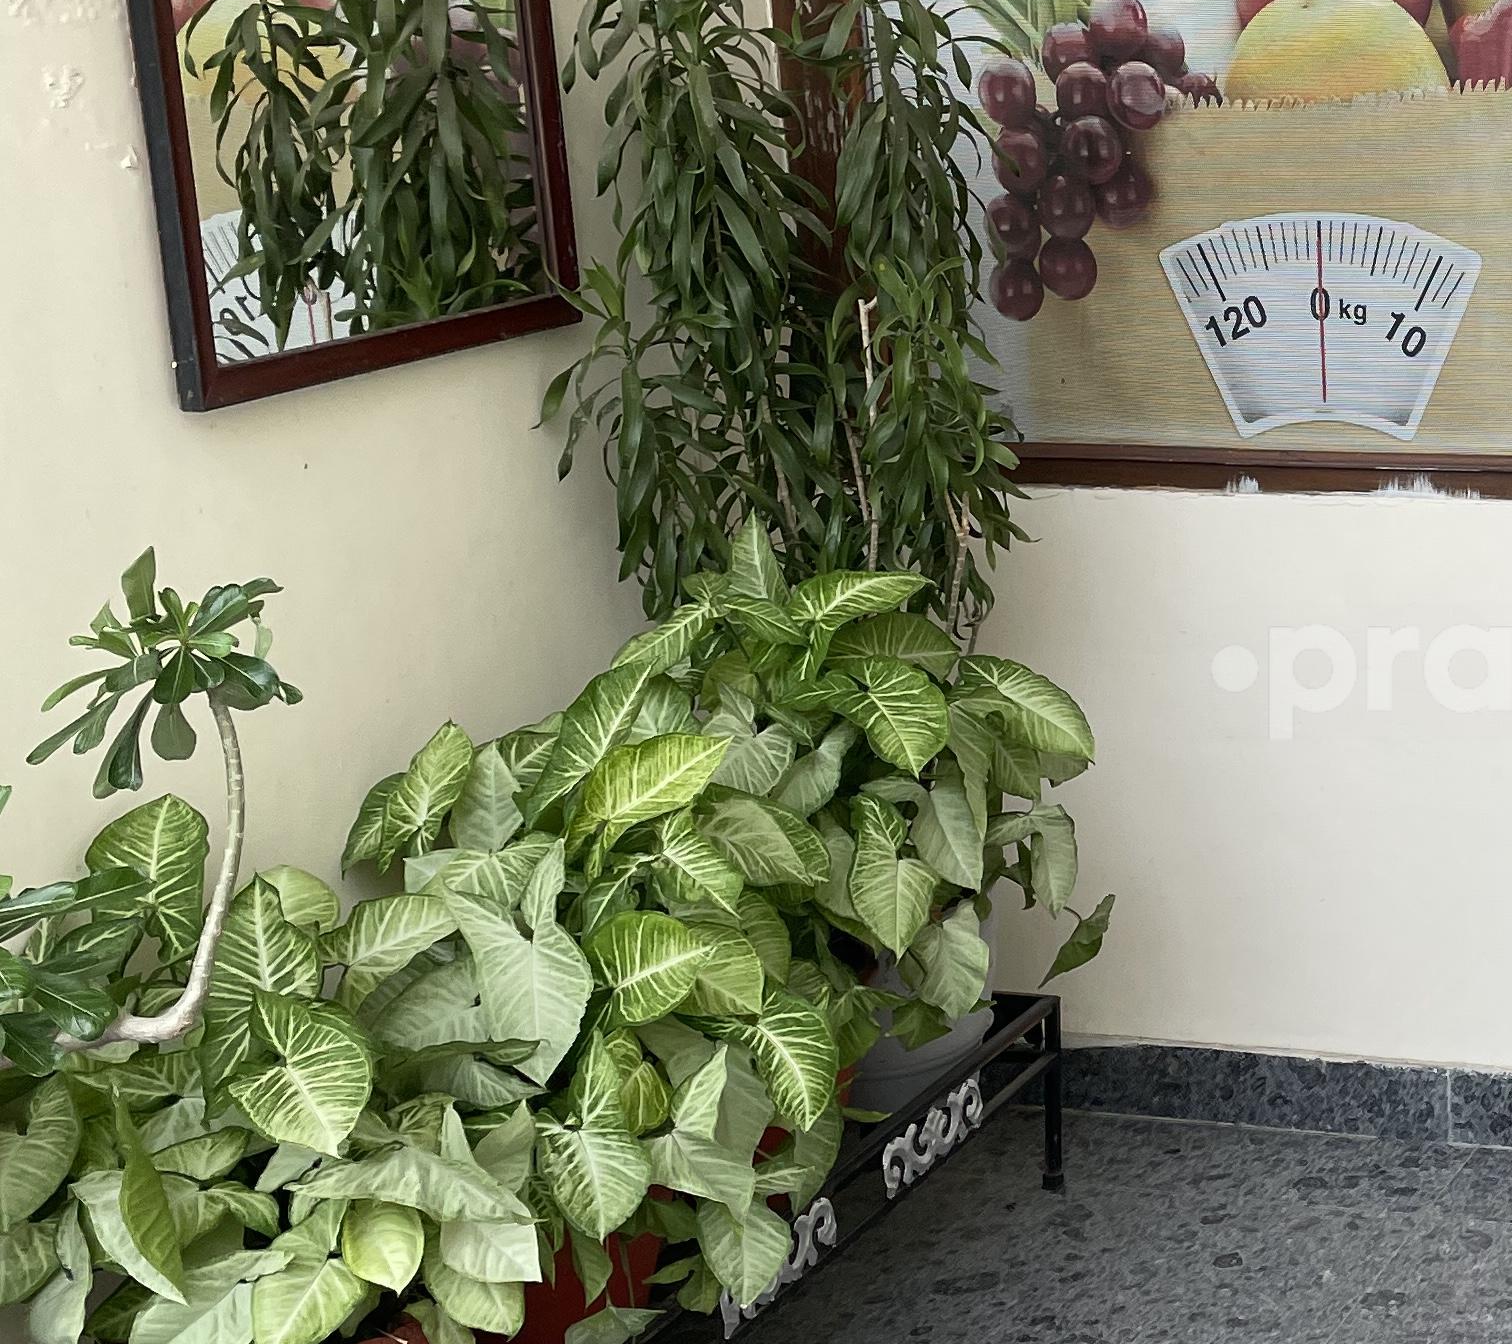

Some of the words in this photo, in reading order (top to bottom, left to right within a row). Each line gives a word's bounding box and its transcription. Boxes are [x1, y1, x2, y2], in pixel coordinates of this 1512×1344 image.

[1204, 294, 1268, 348] 120
[1309, 286, 1332, 322] 0
[1338, 298, 1368, 326] kg
[1385, 310, 1428, 358] 10
